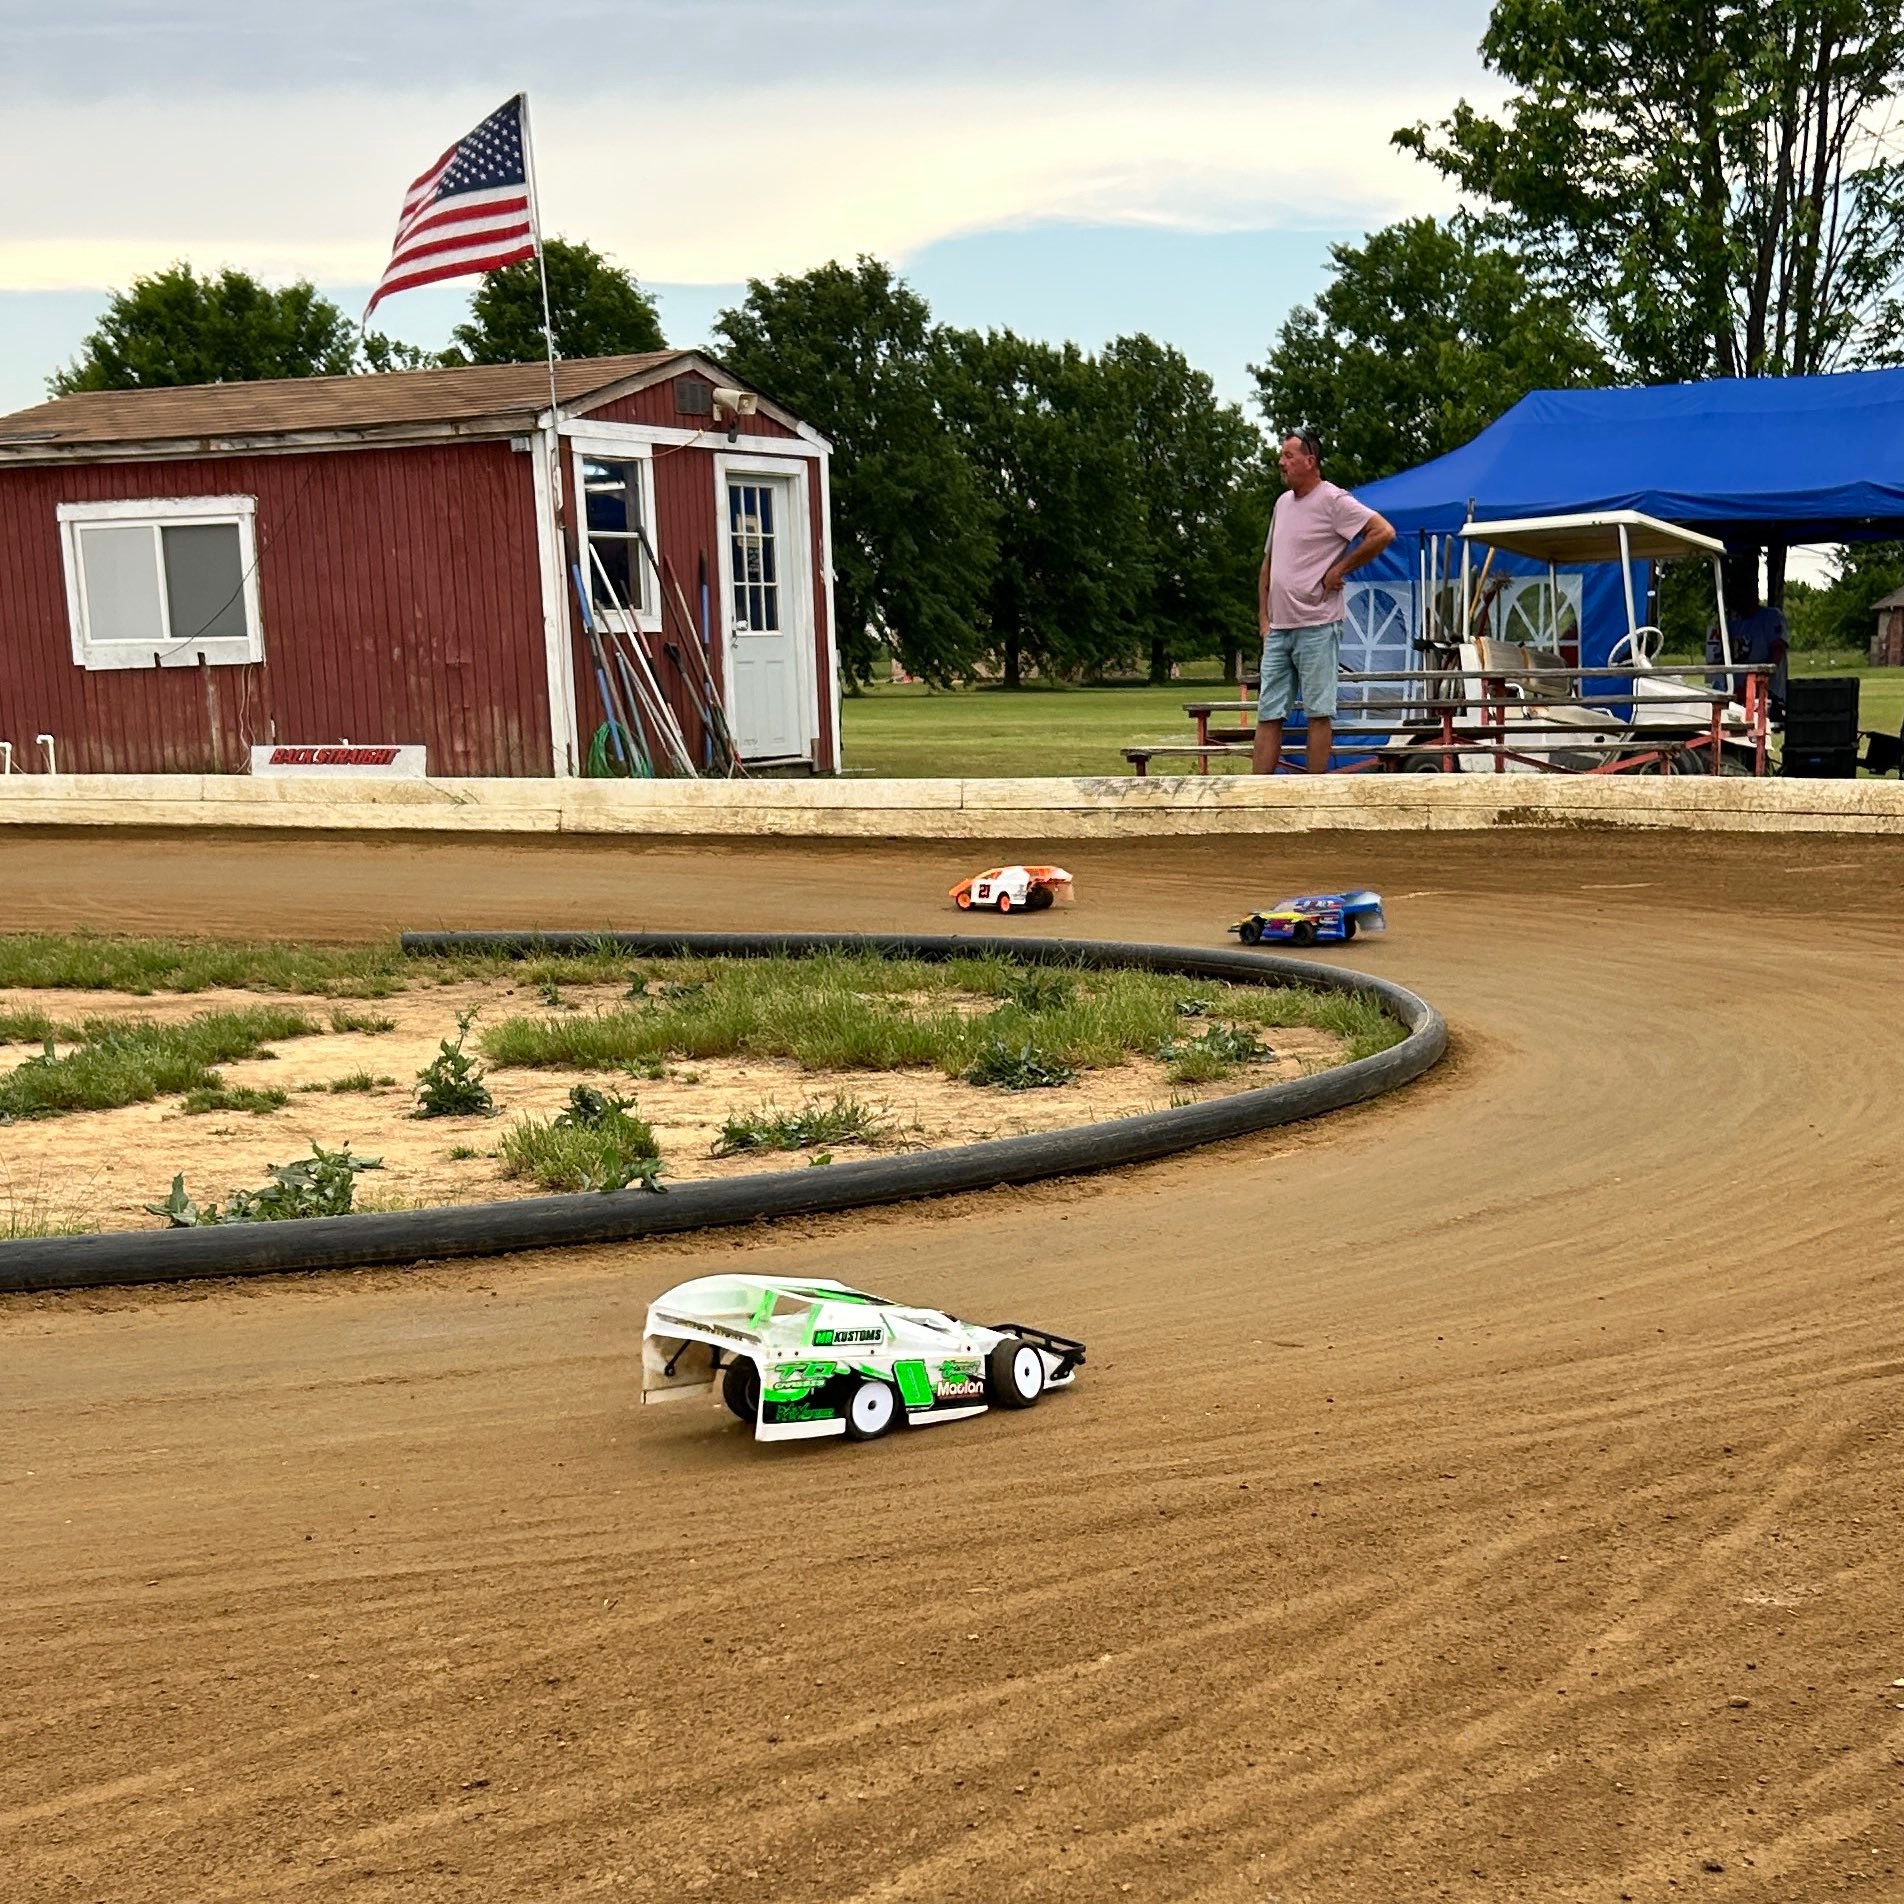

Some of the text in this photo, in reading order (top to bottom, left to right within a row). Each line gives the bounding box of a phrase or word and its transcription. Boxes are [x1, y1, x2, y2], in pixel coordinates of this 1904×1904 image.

[269, 749, 401, 765] BACK STRAIGHT
[834, 1329, 882, 1343] KUSTOMS
[937, 1379, 984, 1397] Maclan
